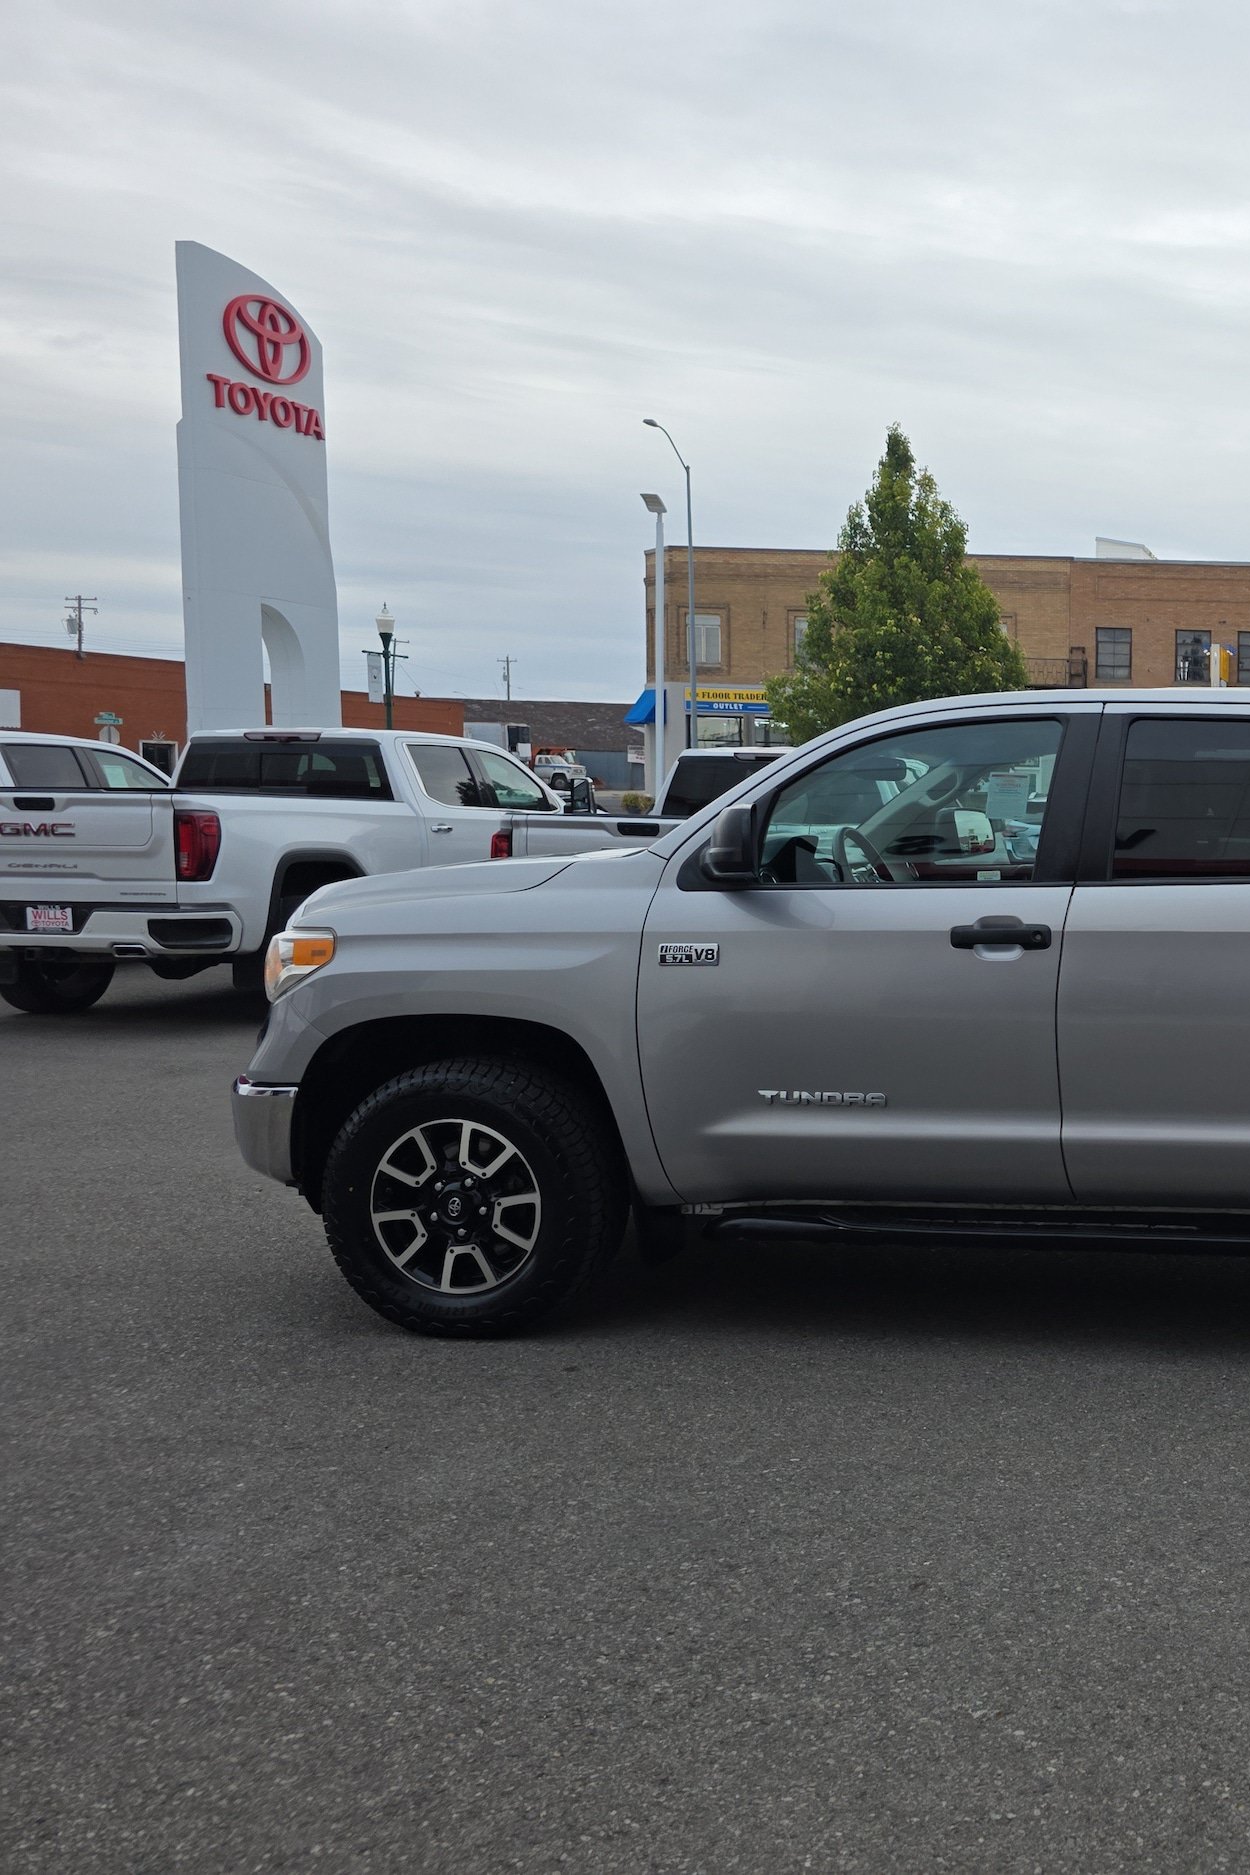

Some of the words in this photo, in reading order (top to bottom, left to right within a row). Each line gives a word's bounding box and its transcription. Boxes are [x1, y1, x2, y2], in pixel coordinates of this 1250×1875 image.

[206, 373, 326, 441] TOYOTA
[701, 691, 731, 700] FLOOR
[712, 702, 744, 710] OUTLET
[0, 822, 76, 837] GMC
[32, 910, 68, 920] WILLS
[695, 949, 714, 961] V8
[757, 1089, 888, 1107] TUNDRA
